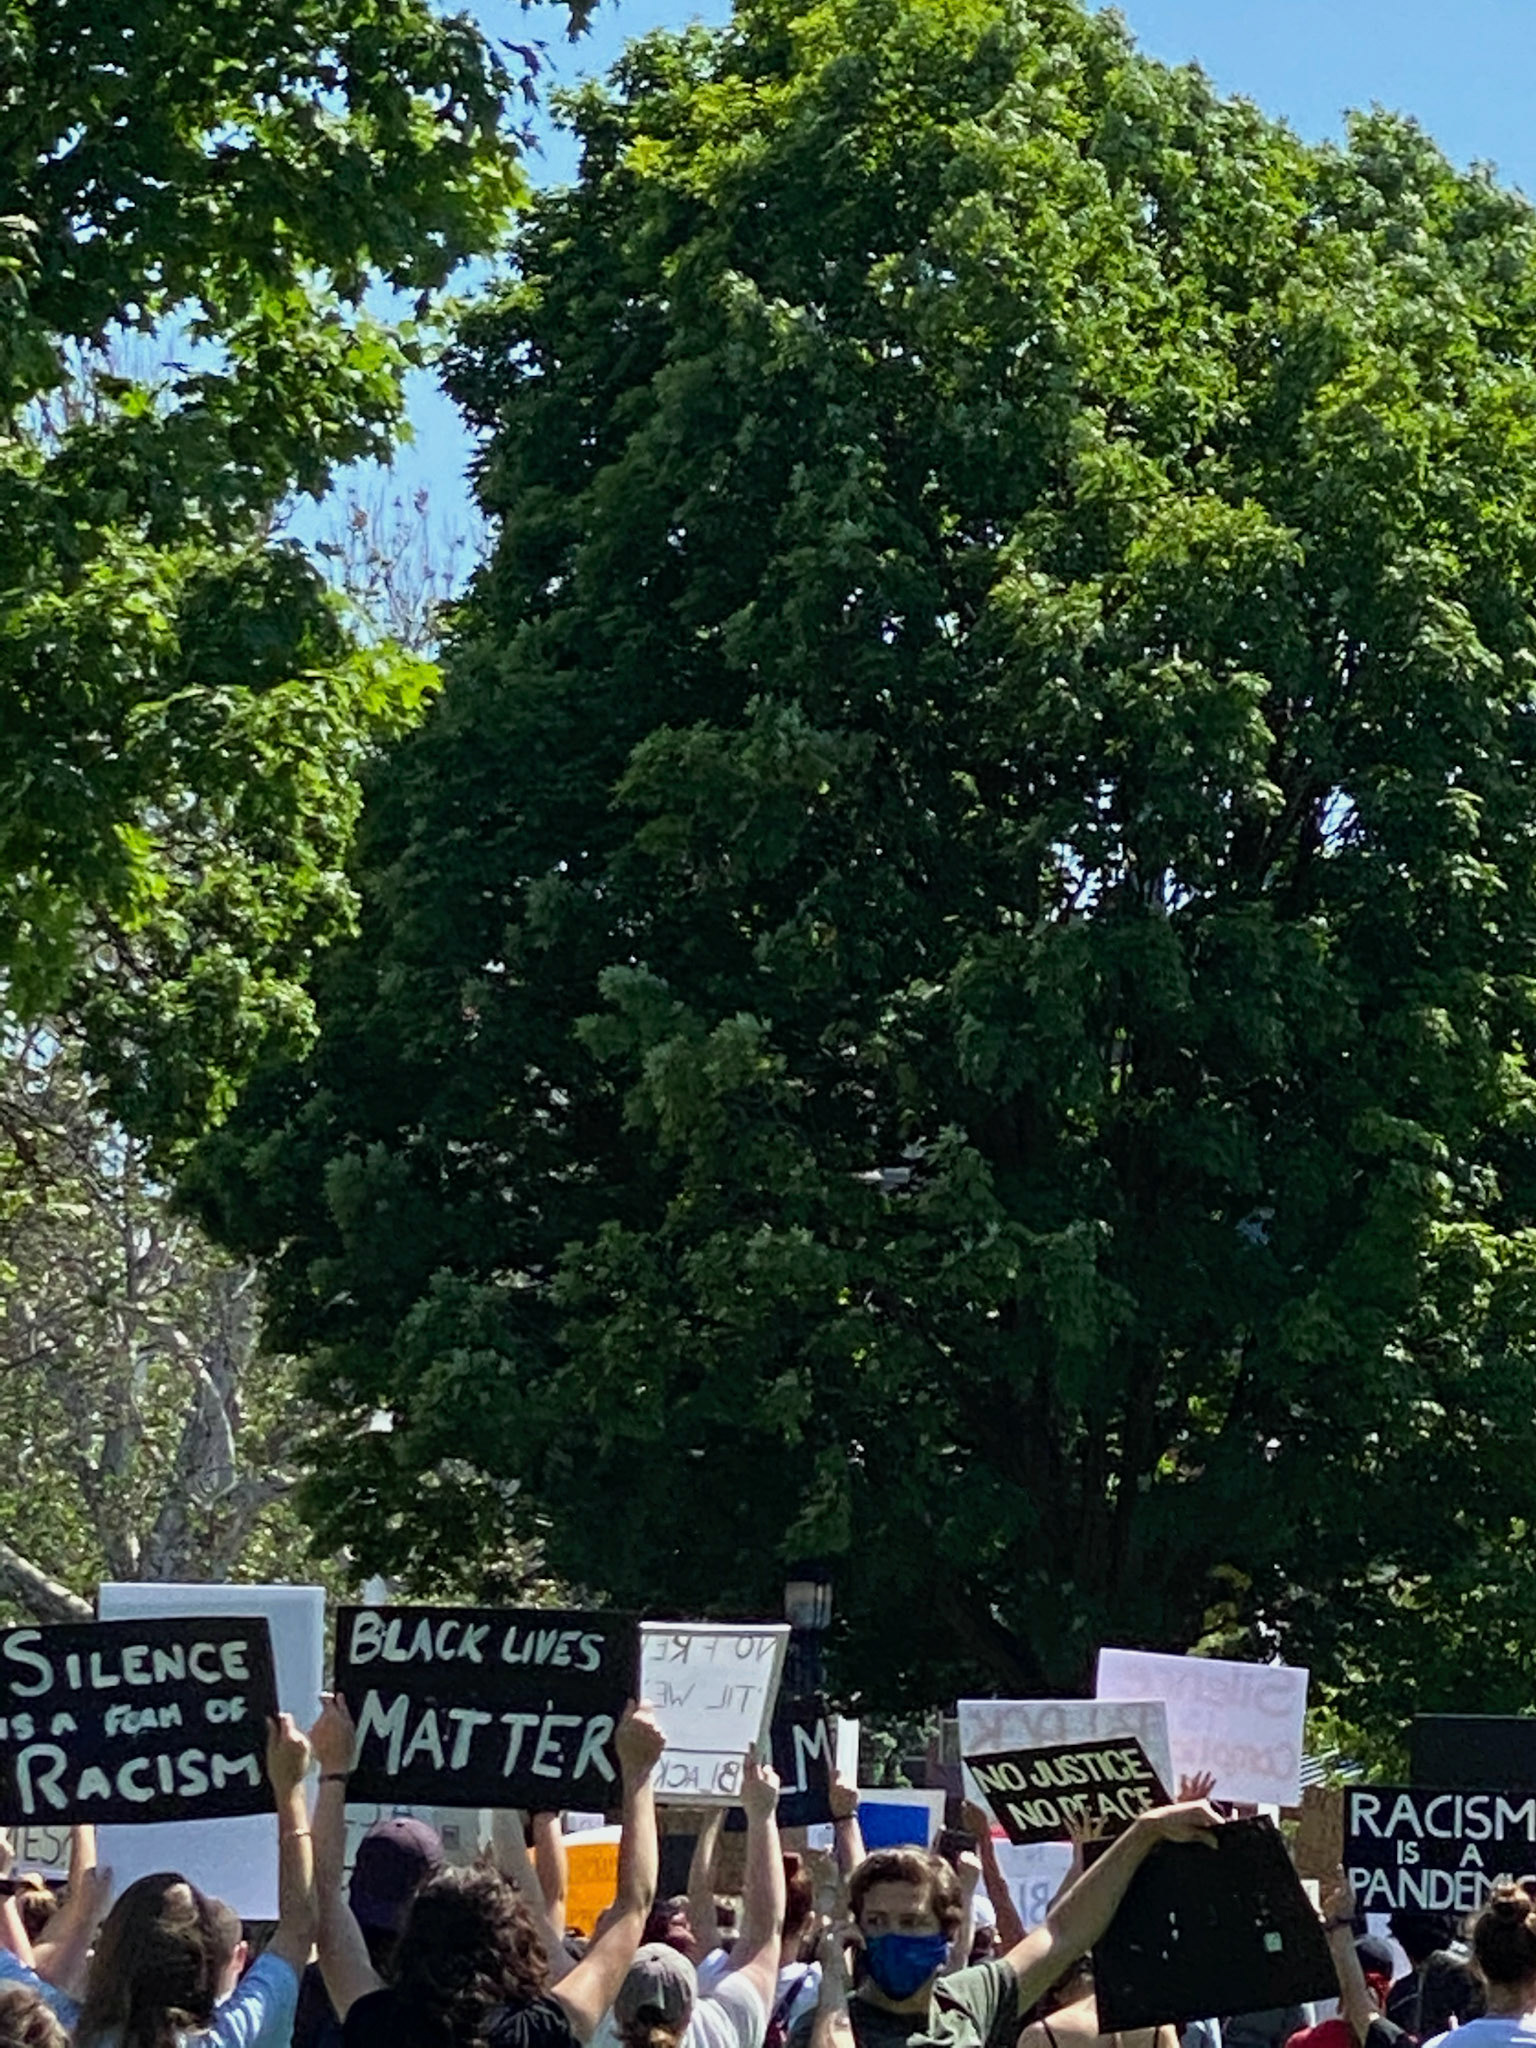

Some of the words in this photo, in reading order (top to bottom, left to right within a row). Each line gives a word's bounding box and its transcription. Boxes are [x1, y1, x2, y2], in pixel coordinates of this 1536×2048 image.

[3, 1629, 250, 1697] SILENCE
[350, 1610, 490, 1665] BLACK
[501, 1625, 605, 1672] LIVES
[51, 1712, 78, 1737] A
[204, 1696, 249, 1724] OF
[350, 1688, 617, 1782] MATTER
[16, 1743, 262, 1814] RACISM
[971, 1761, 1027, 1793] NO
[1030, 1748, 1152, 1788] JUSTICE
[1006, 1797, 1061, 1831] NO
[1350, 1792, 1536, 1842] RACISM
[1396, 1839, 1421, 1865] IS
[1459, 1842, 1485, 1868] A
